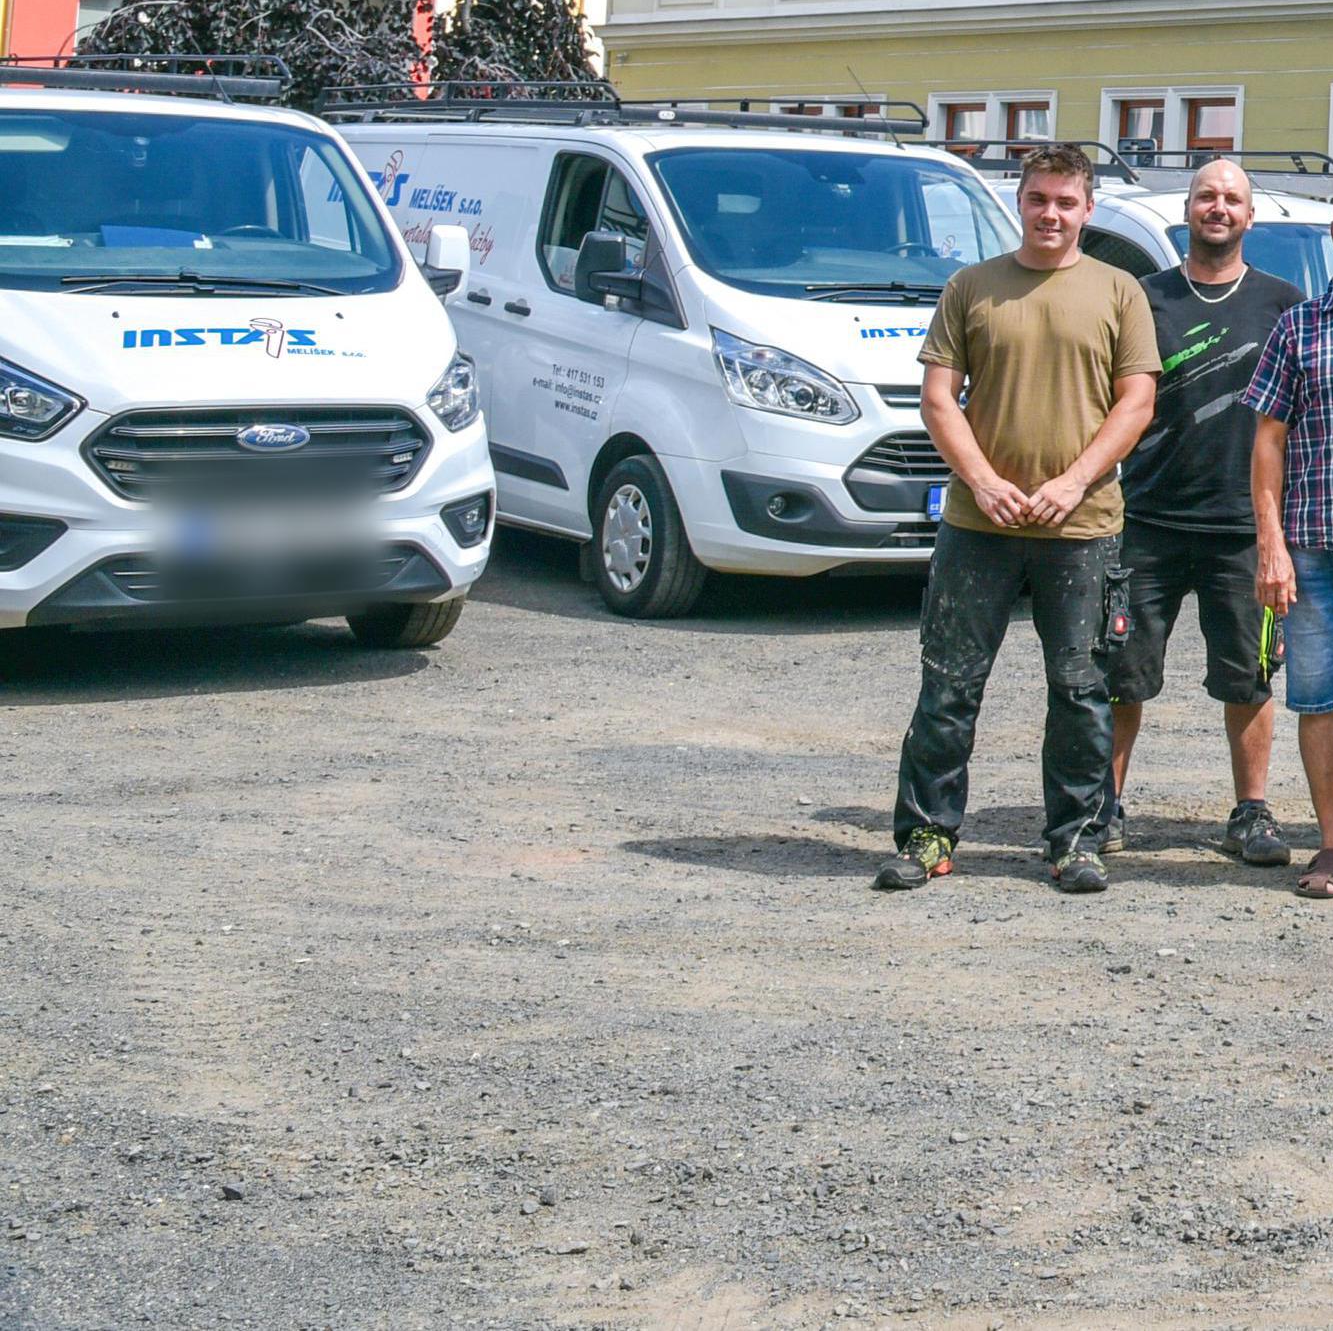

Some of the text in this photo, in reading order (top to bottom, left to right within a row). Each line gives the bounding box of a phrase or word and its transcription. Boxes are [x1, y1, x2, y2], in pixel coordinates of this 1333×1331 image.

[408, 184, 458, 213] MELÍŠEK
[458, 198, 483, 216] s.r.o.
[123, 327, 317, 349] INSTAS
[287, 348, 336, 356] MELÍŠEK
[566, 368, 579, 380] 417
[579, 371, 591, 385] 531
[593, 375, 605, 389] 153
[255, 427, 296, 444] Ford
